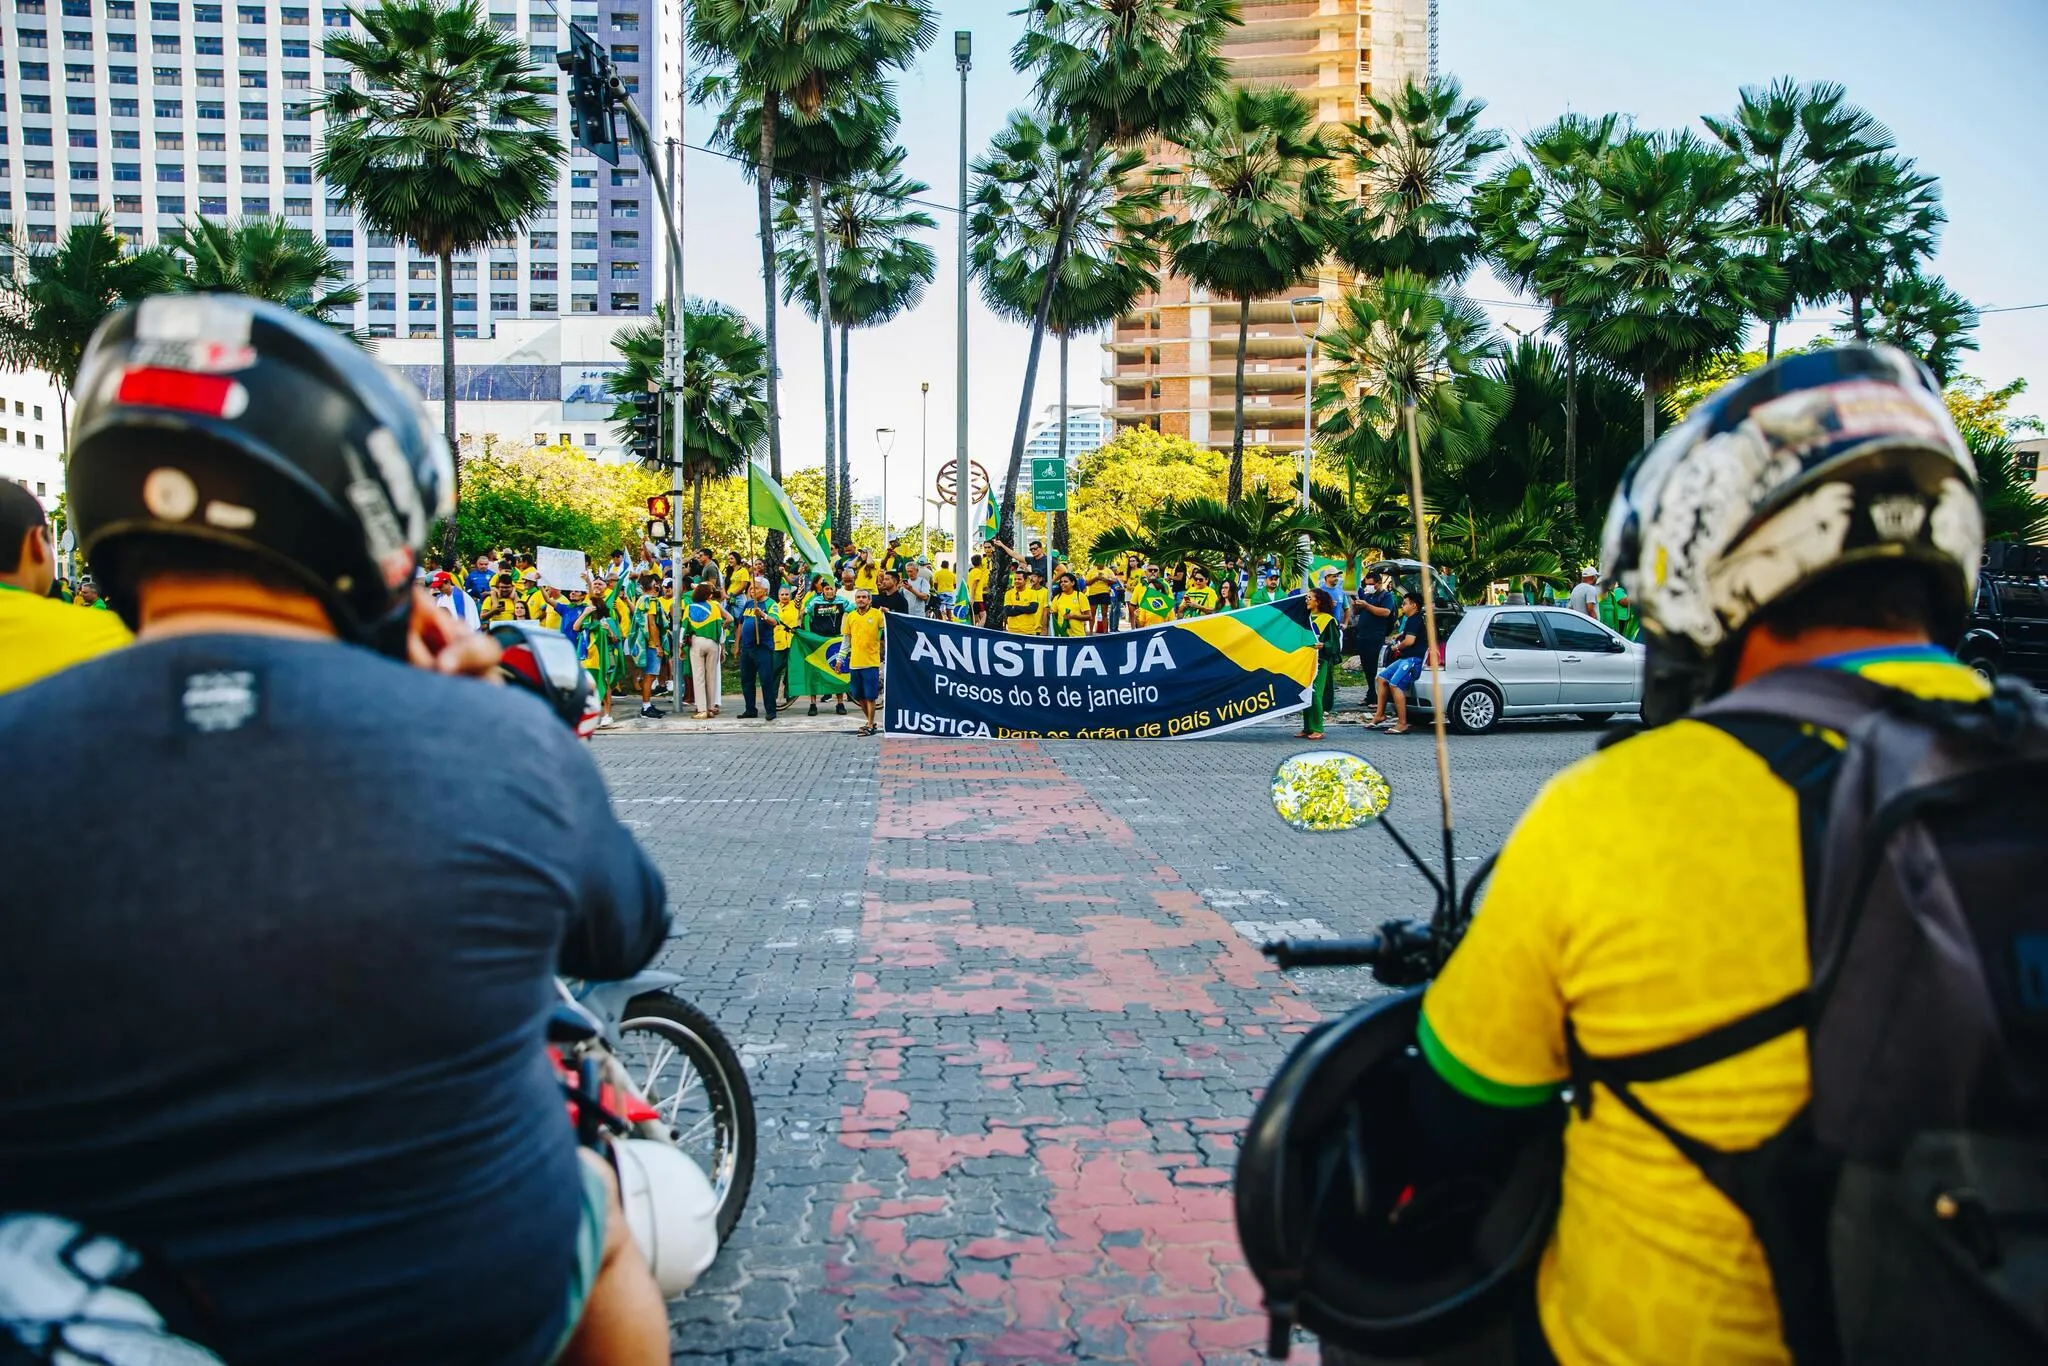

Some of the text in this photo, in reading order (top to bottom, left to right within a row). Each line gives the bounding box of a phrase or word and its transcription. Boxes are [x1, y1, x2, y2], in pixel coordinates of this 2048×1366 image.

[910, 630, 1177, 678] ANISTIA JÁ
[894, 709, 992, 738] JUSTIÇA
[1135, 722, 1161, 738] de
[1167, 710, 1211, 737] pais
[1215, 683, 1277, 721] vivos!
[935, 673, 1159, 713] Presos do 8 de janeiro
